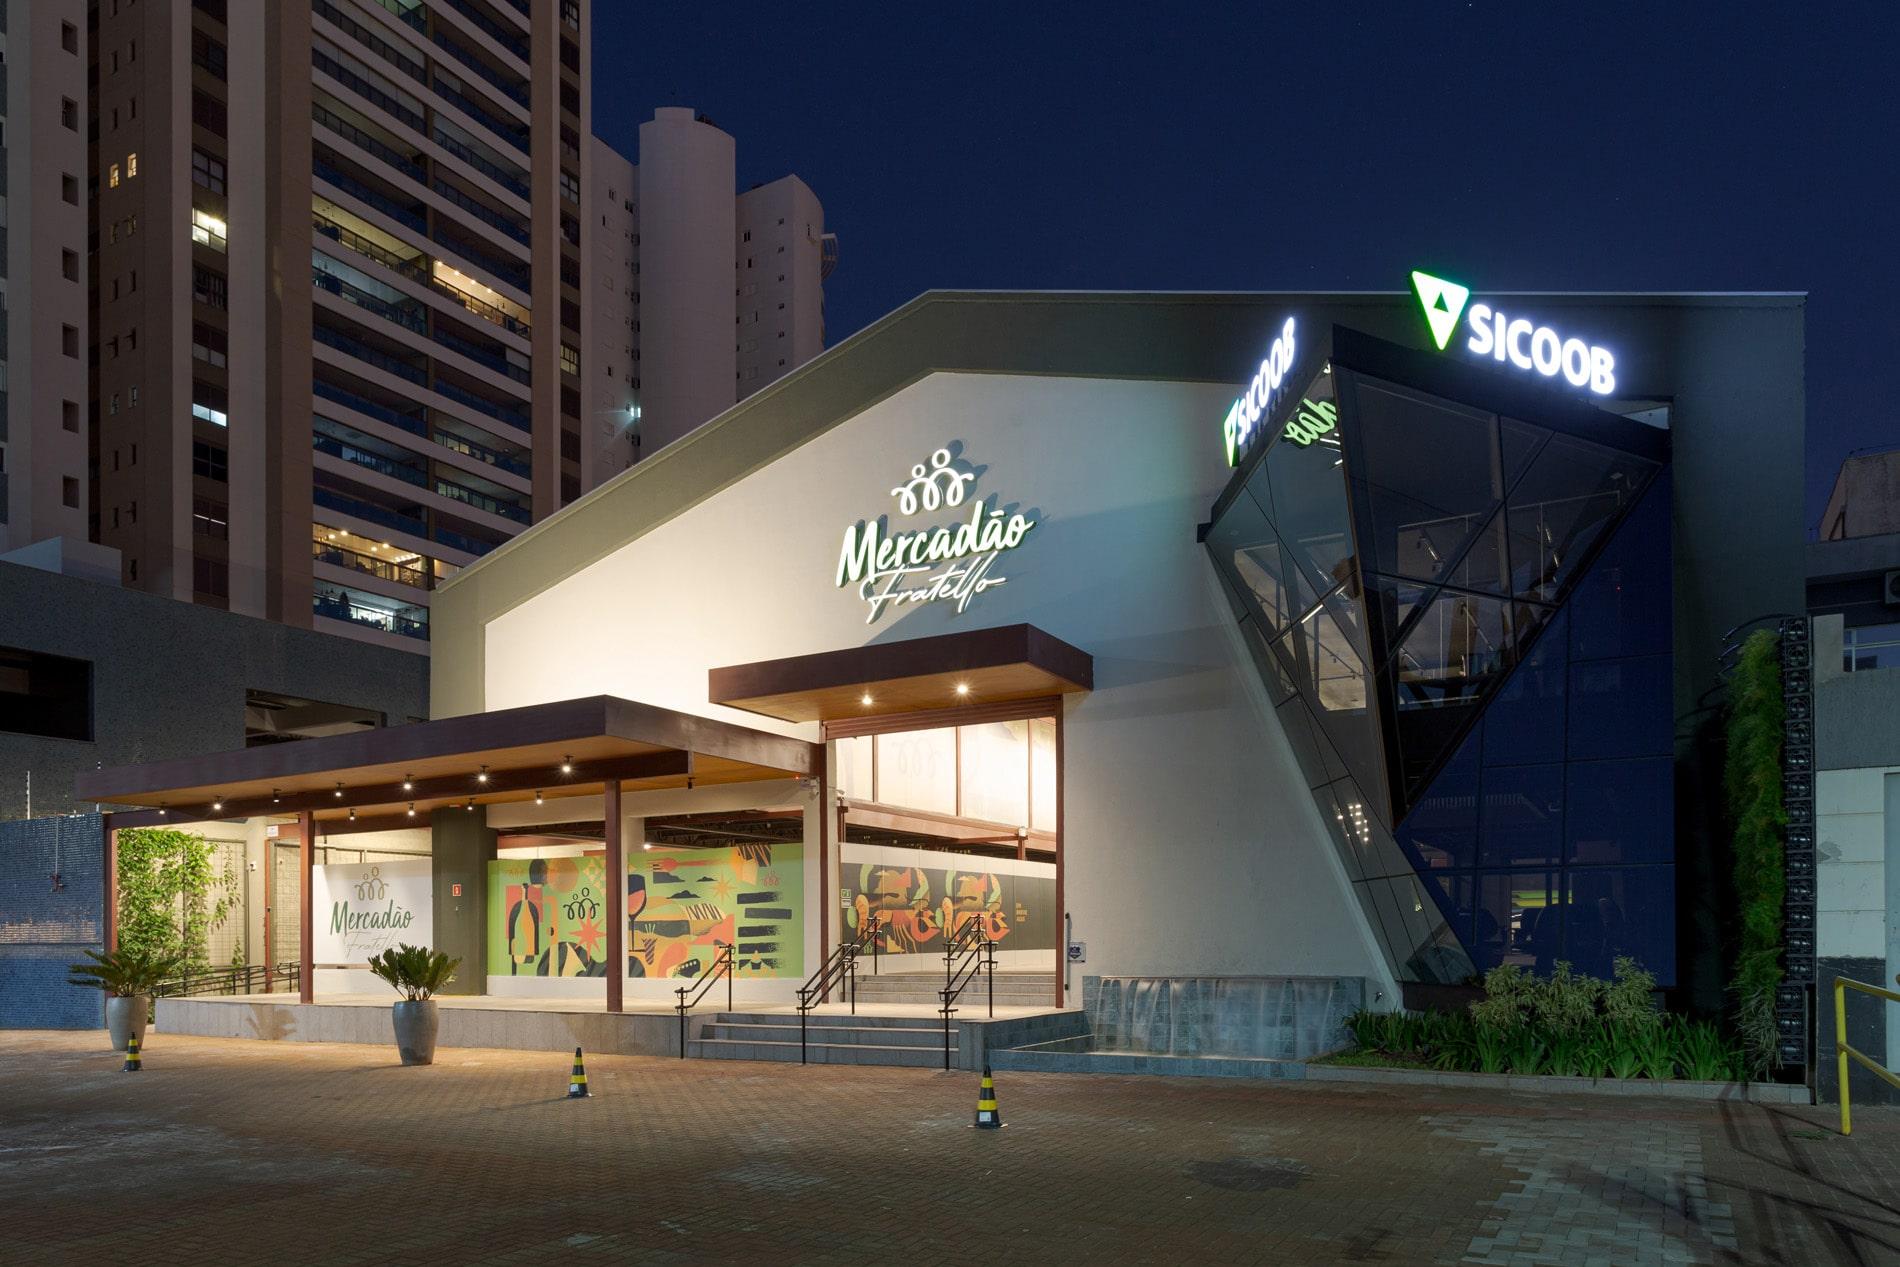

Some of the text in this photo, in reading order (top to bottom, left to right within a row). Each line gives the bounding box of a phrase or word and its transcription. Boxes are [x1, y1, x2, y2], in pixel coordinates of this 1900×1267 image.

[1237, 316, 1296, 446] SICOOB
[1467, 303, 1616, 396] SICOOB
[835, 500, 1036, 588] Mercadão
[858, 550, 1007, 625] Fratello
[328, 898, 416, 937] Mercadão
